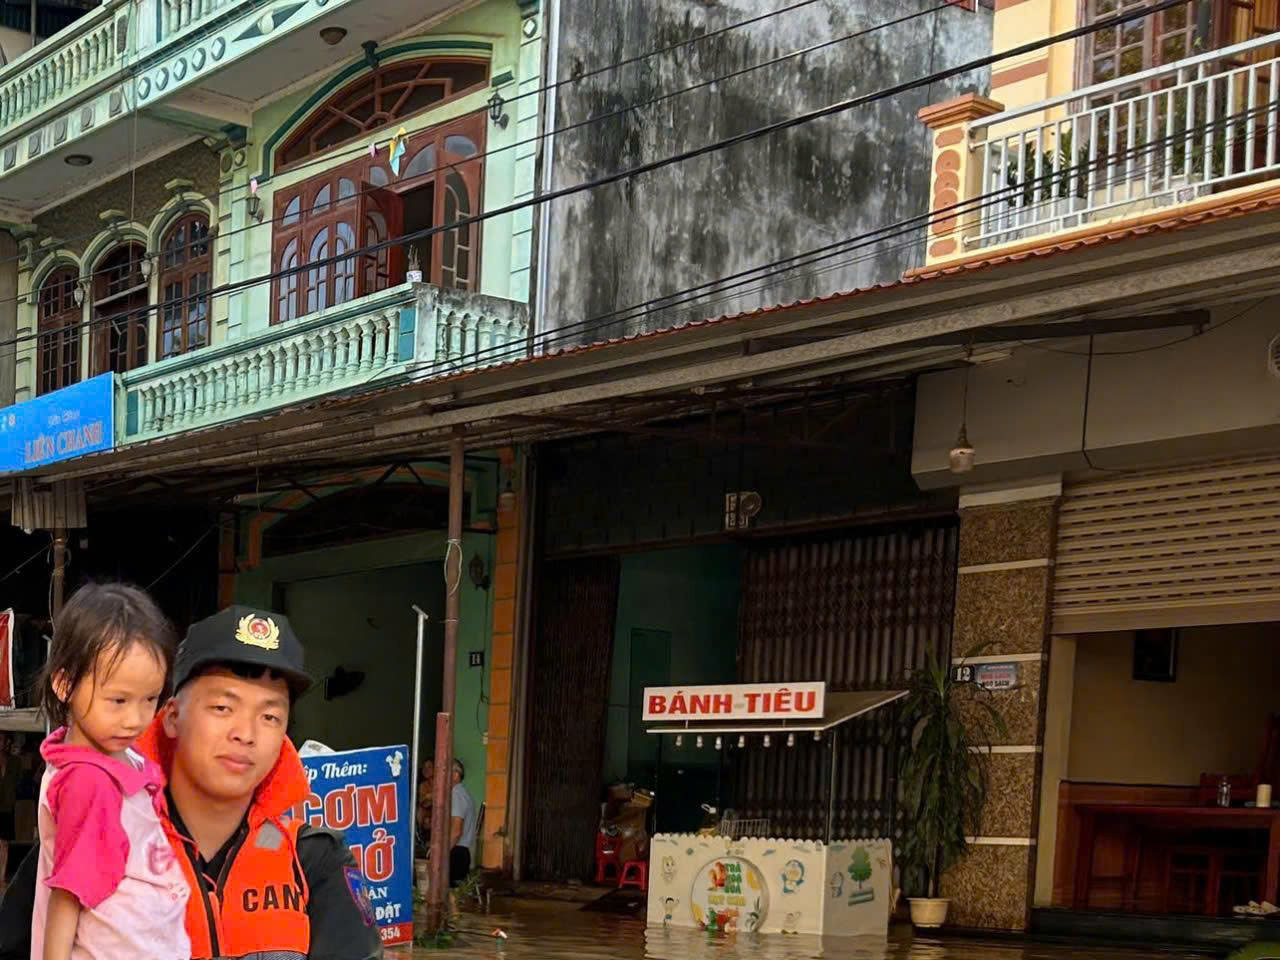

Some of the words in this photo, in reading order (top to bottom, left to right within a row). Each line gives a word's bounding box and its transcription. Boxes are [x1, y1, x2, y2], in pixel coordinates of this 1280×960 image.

[956, 666, 971, 682] 12
[647, 690, 733, 715] BÁNH
[743, 687, 816, 713] TIÊU
[321, 760, 368, 779] Thêm:
[292, 782, 399, 831] CƠM
